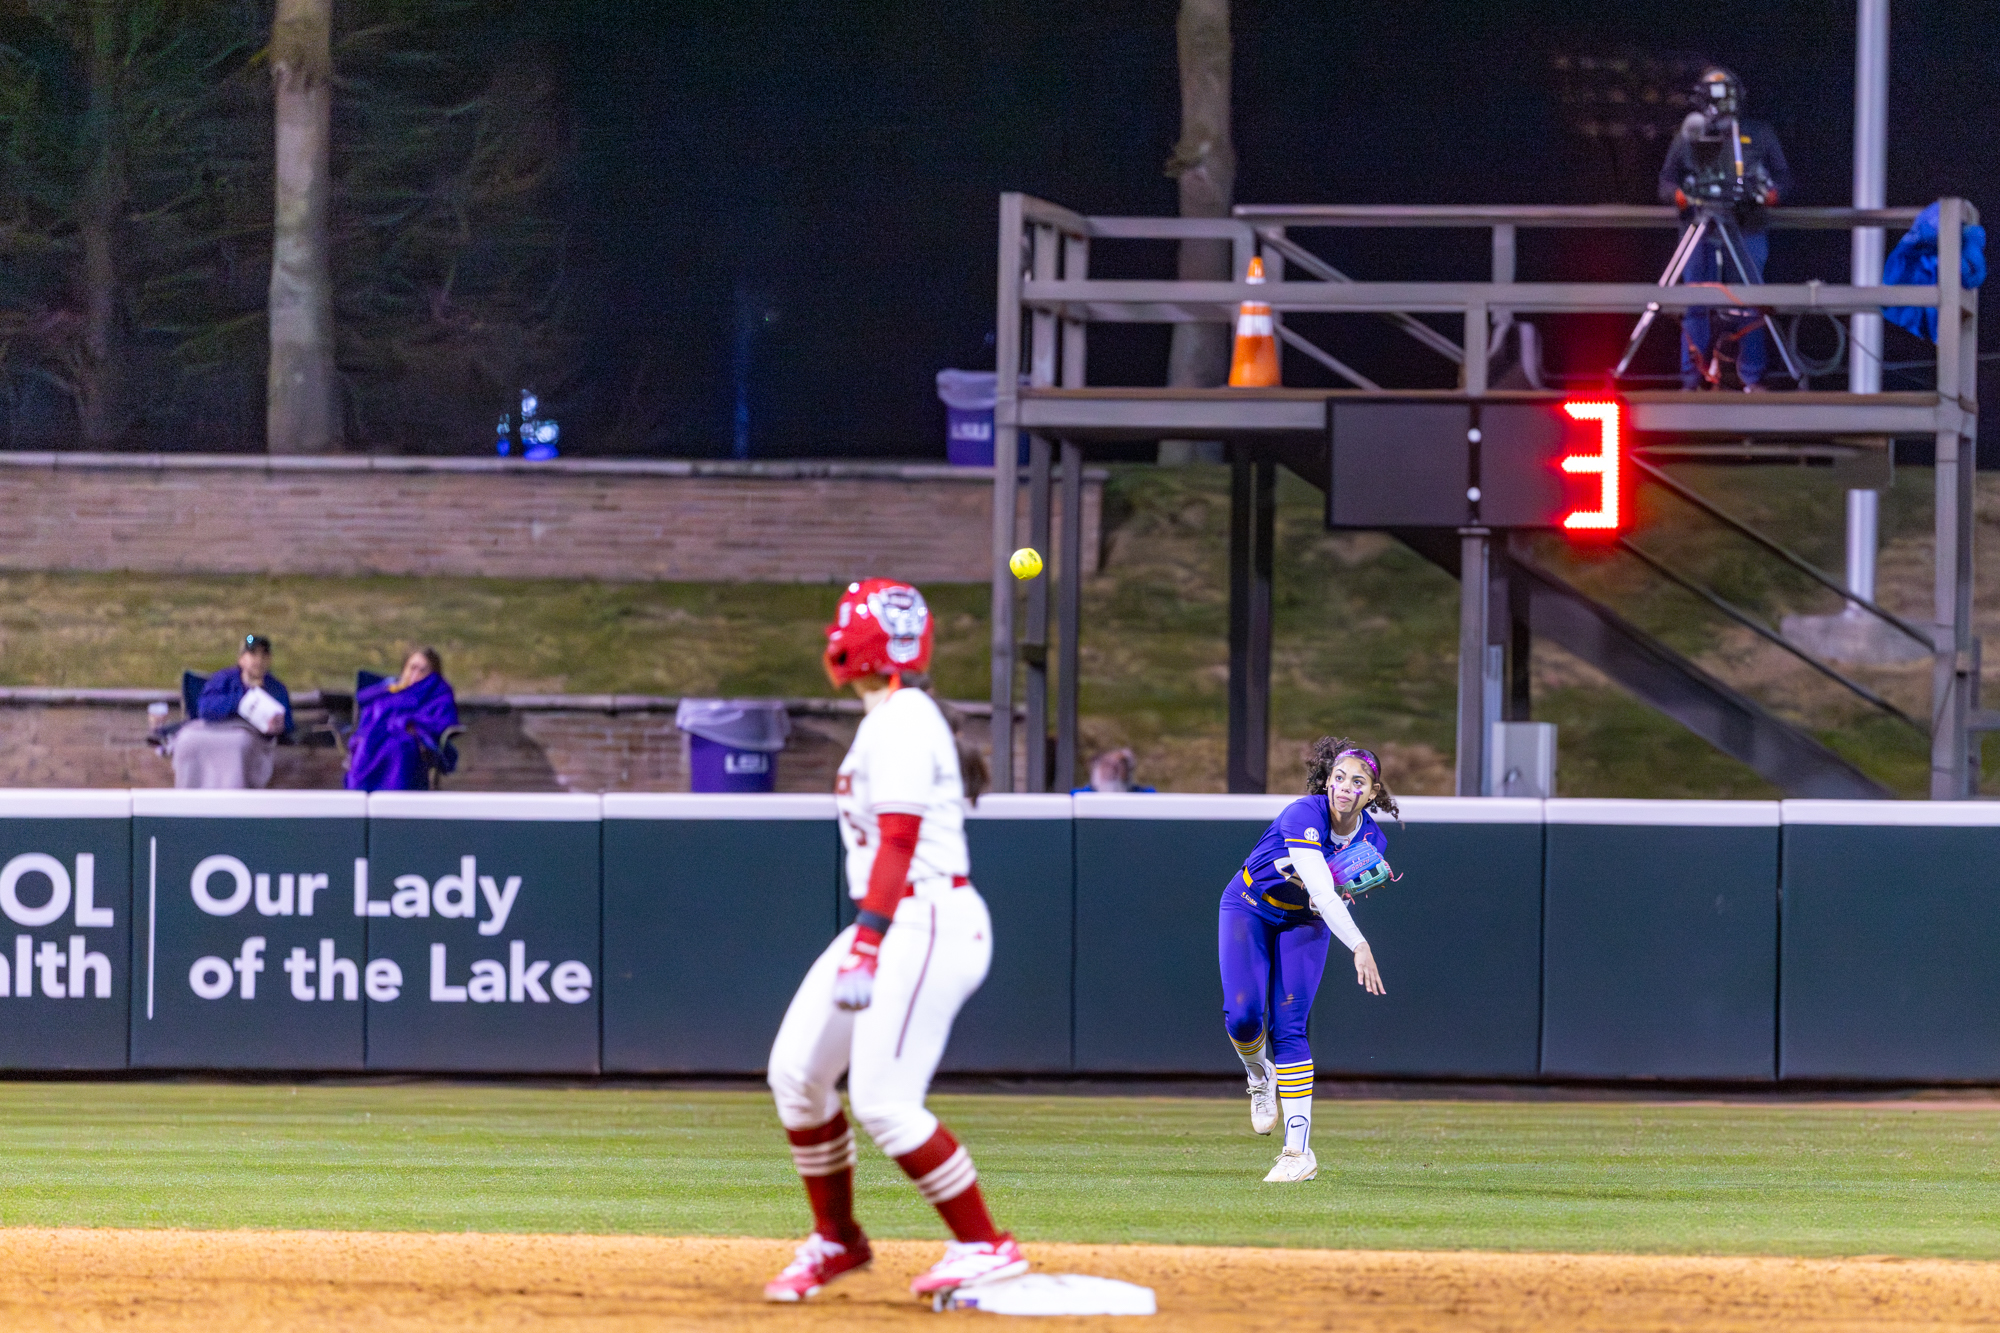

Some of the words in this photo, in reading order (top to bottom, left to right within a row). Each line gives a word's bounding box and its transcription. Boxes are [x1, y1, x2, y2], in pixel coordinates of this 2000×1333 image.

[1561, 401, 1619, 529] 3
[190, 855, 329, 916] Our
[354, 855, 522, 936] Lady
[189, 936, 266, 1000] of
[284, 938, 403, 1002] the
[430, 940, 592, 1004] Lake
